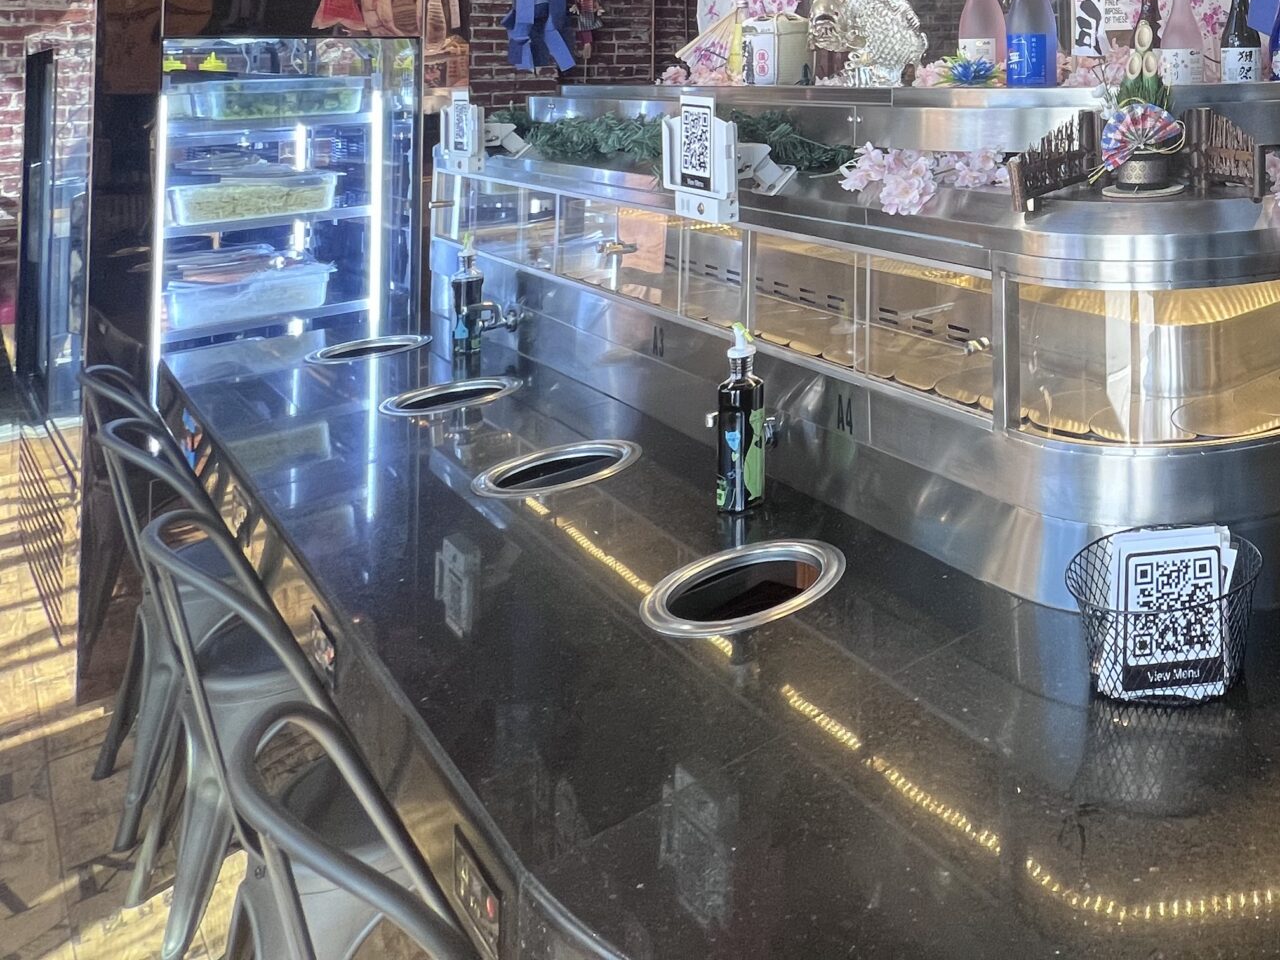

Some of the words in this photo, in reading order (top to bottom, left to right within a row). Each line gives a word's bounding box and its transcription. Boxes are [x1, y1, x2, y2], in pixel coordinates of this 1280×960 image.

[837, 394, 853, 435] A4
[1147, 669, 1171, 683] View
[1173, 667, 1200, 681] Menu
